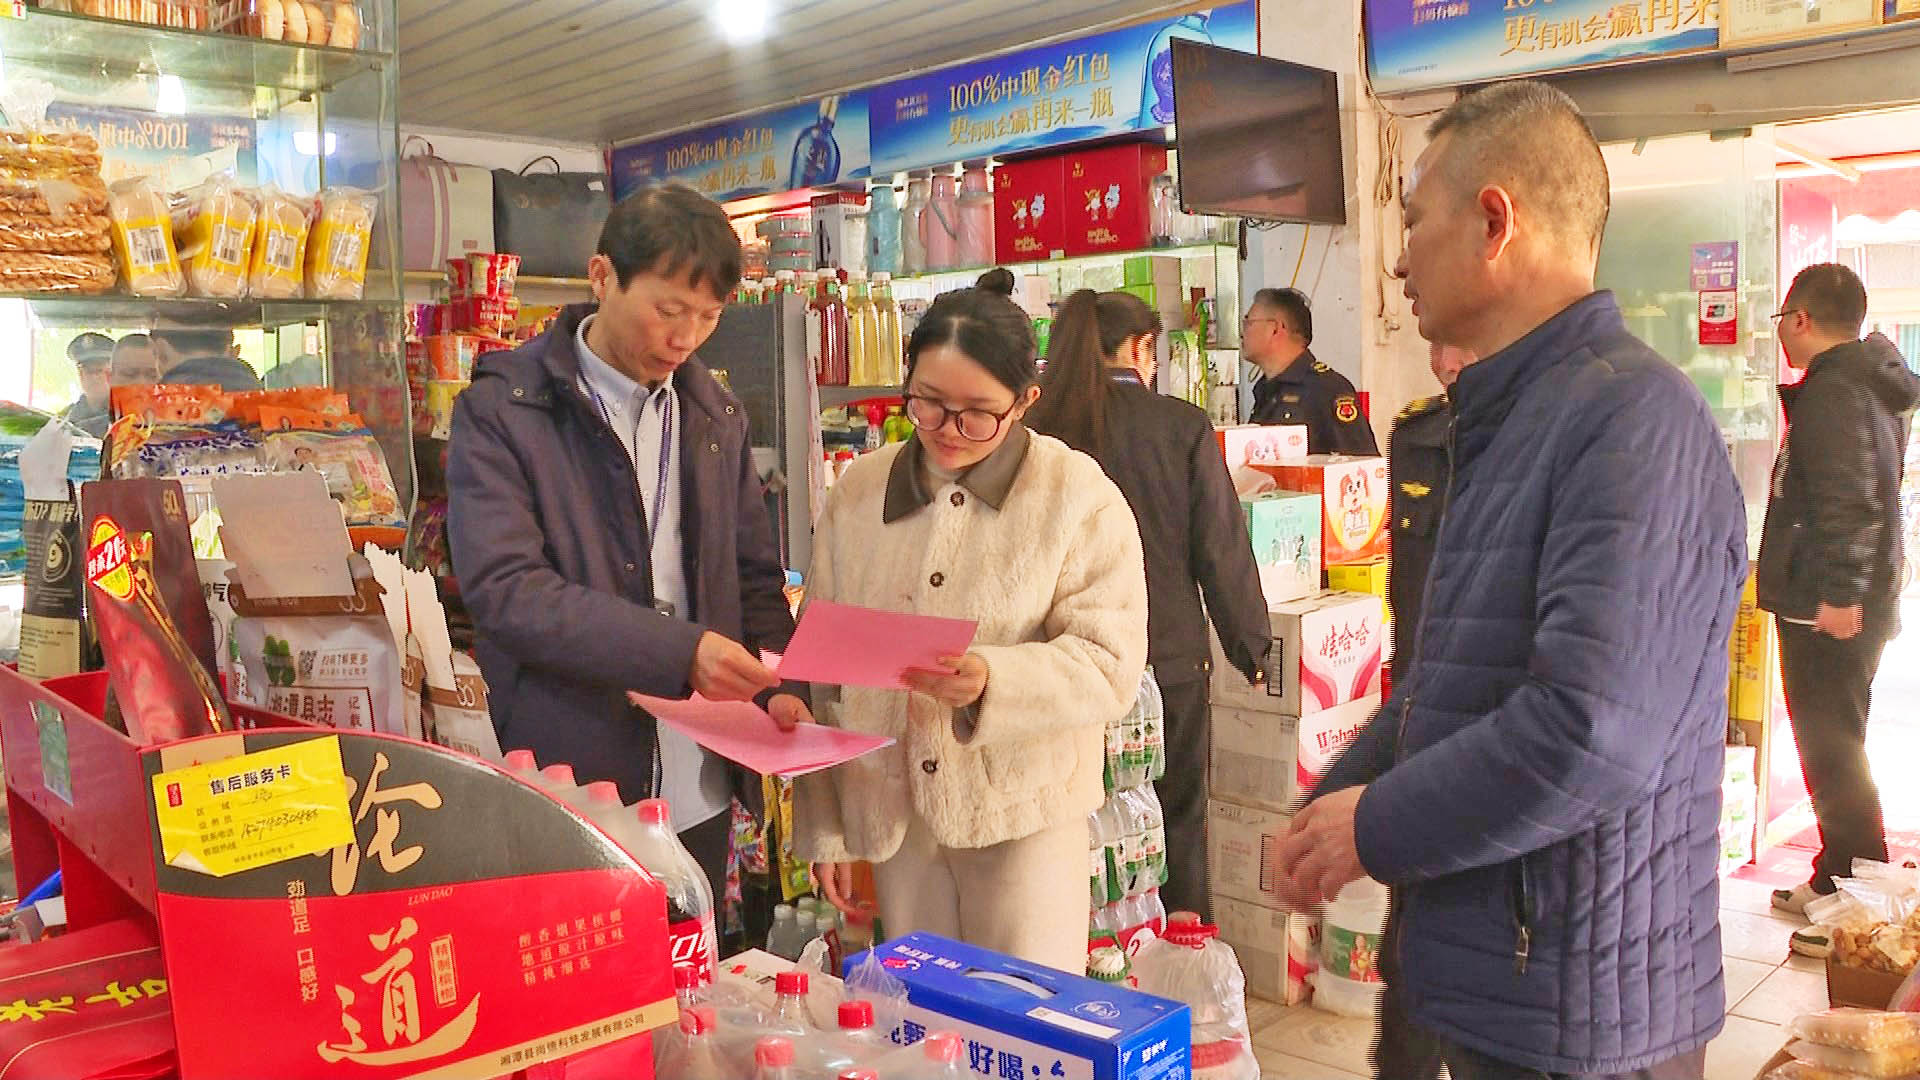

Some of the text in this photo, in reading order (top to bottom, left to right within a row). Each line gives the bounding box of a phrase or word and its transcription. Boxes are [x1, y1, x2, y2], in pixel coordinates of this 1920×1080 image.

[948, 53, 1111, 113] 100%中现金红包
[948, 86, 1115, 147] 更有机会赢再来一瓶
[666, 127, 774, 173] 100%中现金红包
[1319, 615, 1370, 659] 娃哈哈
[210, 764, 291, 795] 售后服务卡
[286, 879, 319, 1002] 劲道足 口感好
[968, 1039, 1025, 1080] 好喝
